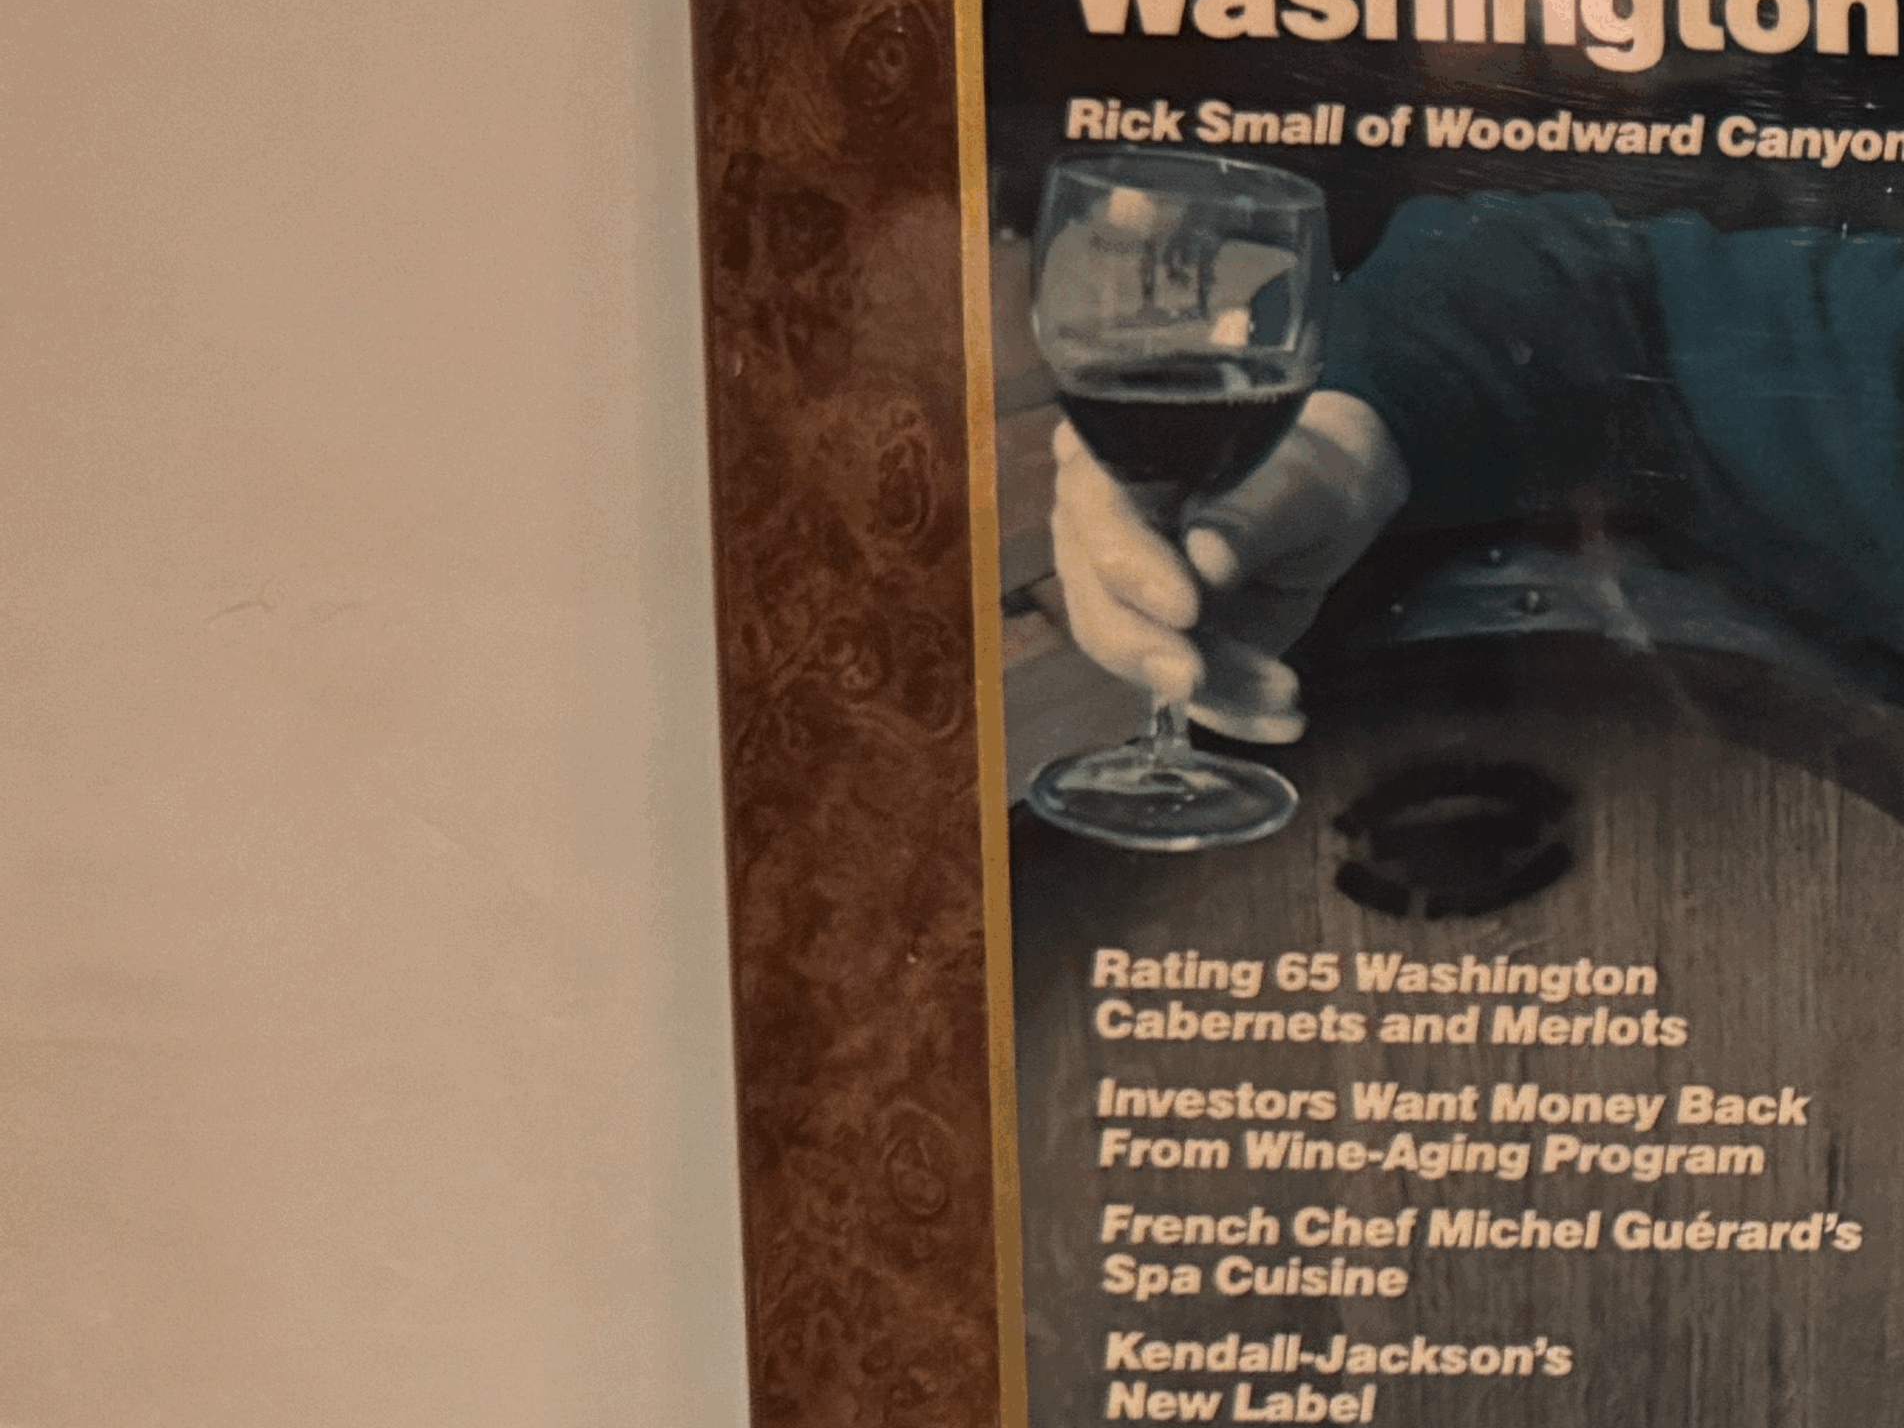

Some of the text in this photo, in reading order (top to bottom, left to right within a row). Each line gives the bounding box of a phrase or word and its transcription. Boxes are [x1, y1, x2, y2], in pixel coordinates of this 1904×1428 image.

[1065, 98, 1182, 143] Rick
[1195, 101, 1345, 147] Small
[1356, 104, 1411, 147] of
[1424, 108, 1704, 157] Woodward
[1092, 948, 1658, 1000] Rating 65 Washington
[1094, 1000, 1688, 1047] Cabernets and Merlots
[1096, 1078, 1812, 1132] Investors Want Money Back
[1098, 1129, 1765, 1182] From Wine-Aging Program
[1100, 1205, 1280, 1246] French
[1293, 1208, 1417, 1247] Chef
[1428, 1208, 1601, 1249] Michel
[1102, 1255, 1408, 1301] Spa Cuisine
[1104, 1331, 1574, 1377] Kendall-Jackson's
[1106, 1381, 1377, 1424] New Label
